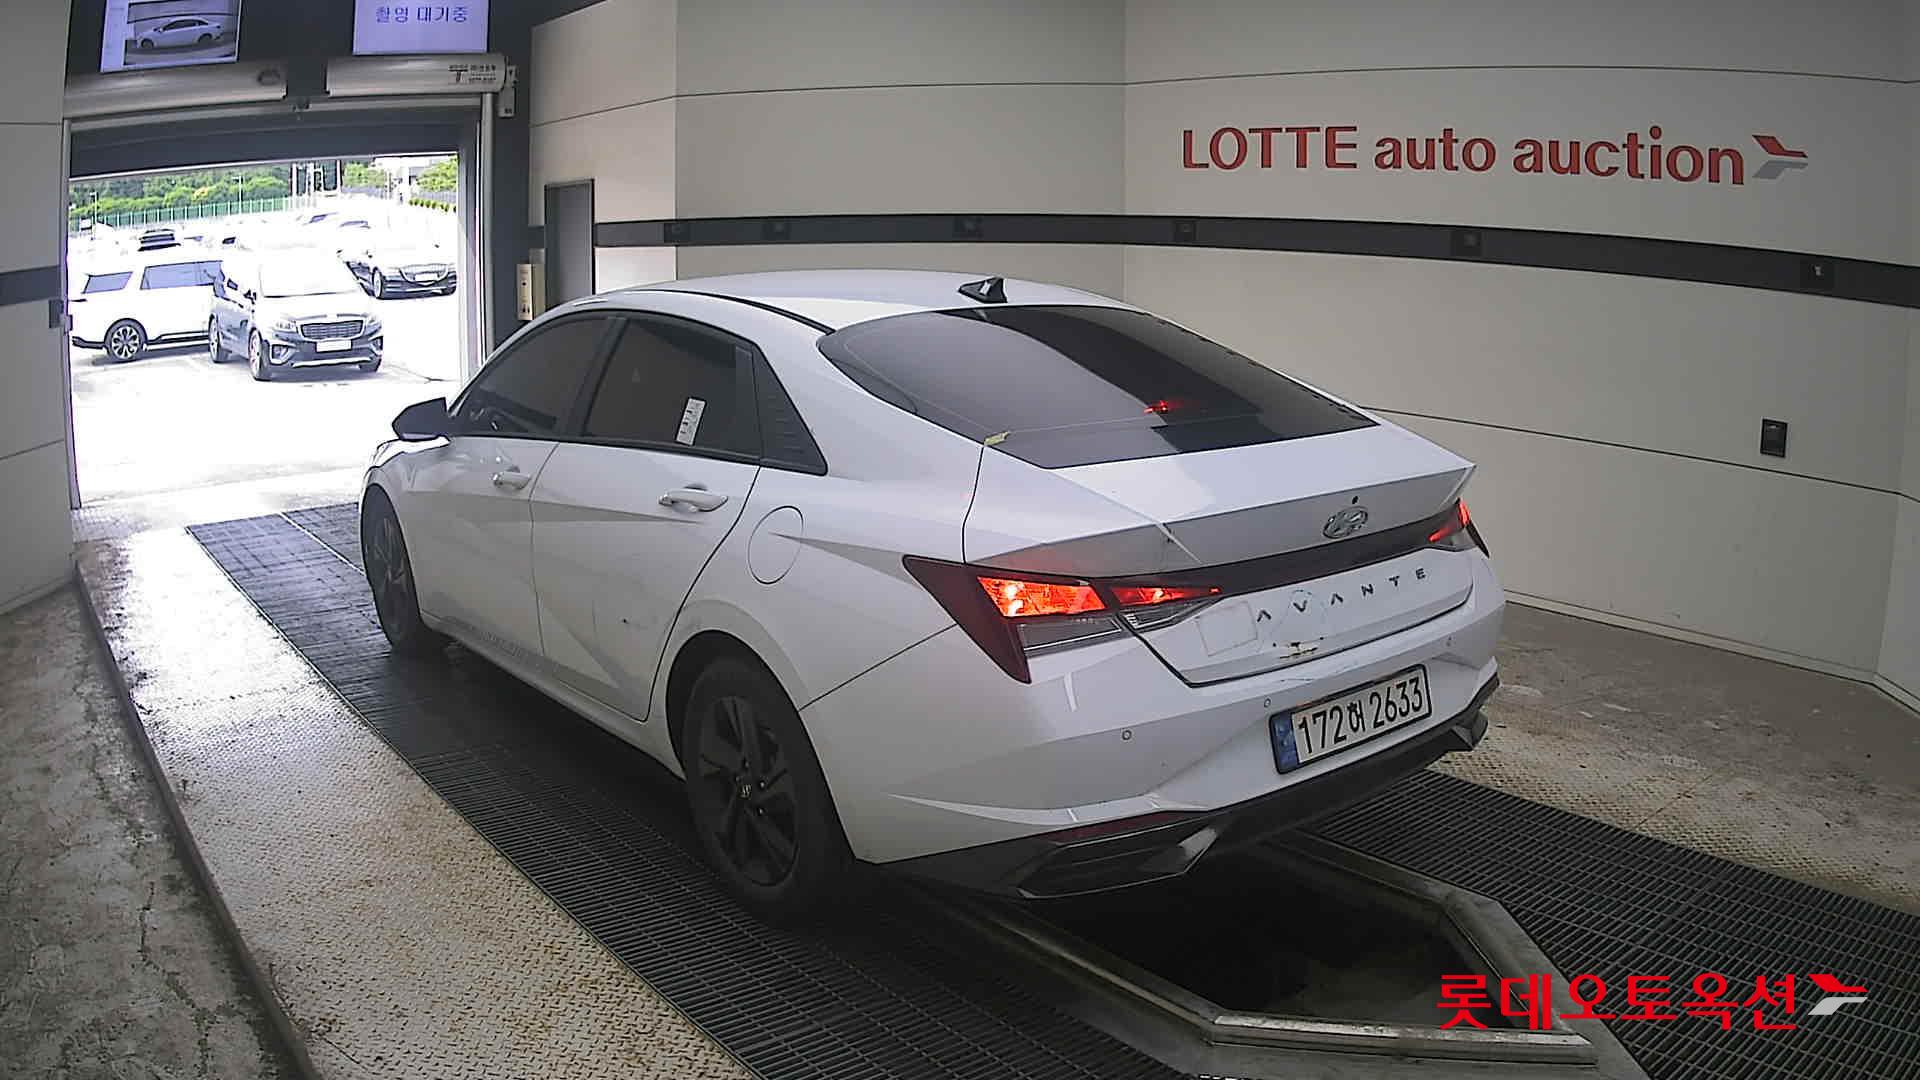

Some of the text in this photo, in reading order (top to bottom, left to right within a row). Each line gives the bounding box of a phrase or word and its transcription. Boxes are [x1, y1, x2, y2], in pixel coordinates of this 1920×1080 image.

[416, 6, 467, 23] 대기중
[1181, 124, 1745, 185] LOTTE auto auction
[1369, 676, 1424, 729] 2633
